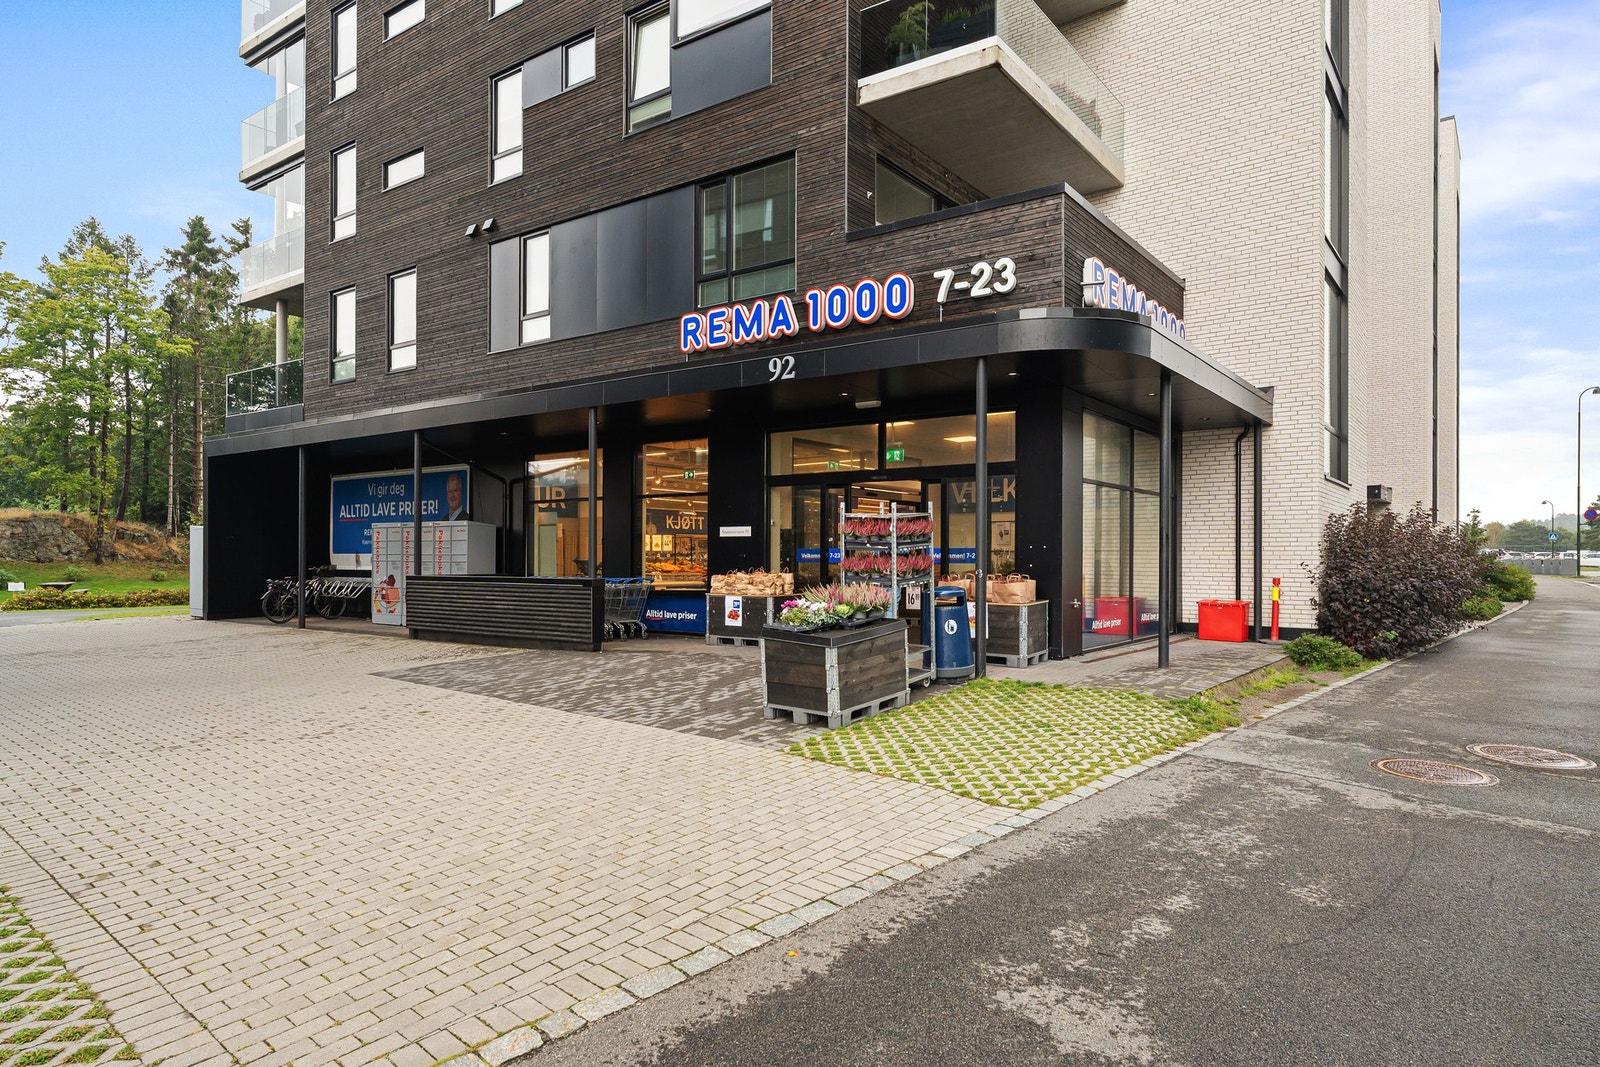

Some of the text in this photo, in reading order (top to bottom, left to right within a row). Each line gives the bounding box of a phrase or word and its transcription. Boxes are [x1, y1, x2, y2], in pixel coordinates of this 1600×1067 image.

[933, 257, 1016, 304] 7-23
[1083, 256, 1148, 316] REMA
[680, 271, 916, 355] REMA 1000
[768, 355, 796, 382] 92
[367, 482, 405, 498] Vi gir deg
[339, 499, 439, 518] ALLTID LAVE PRIER!
[666, 515, 704, 530] KJØTT
[646, 609, 697, 620] Alltid lave priser
